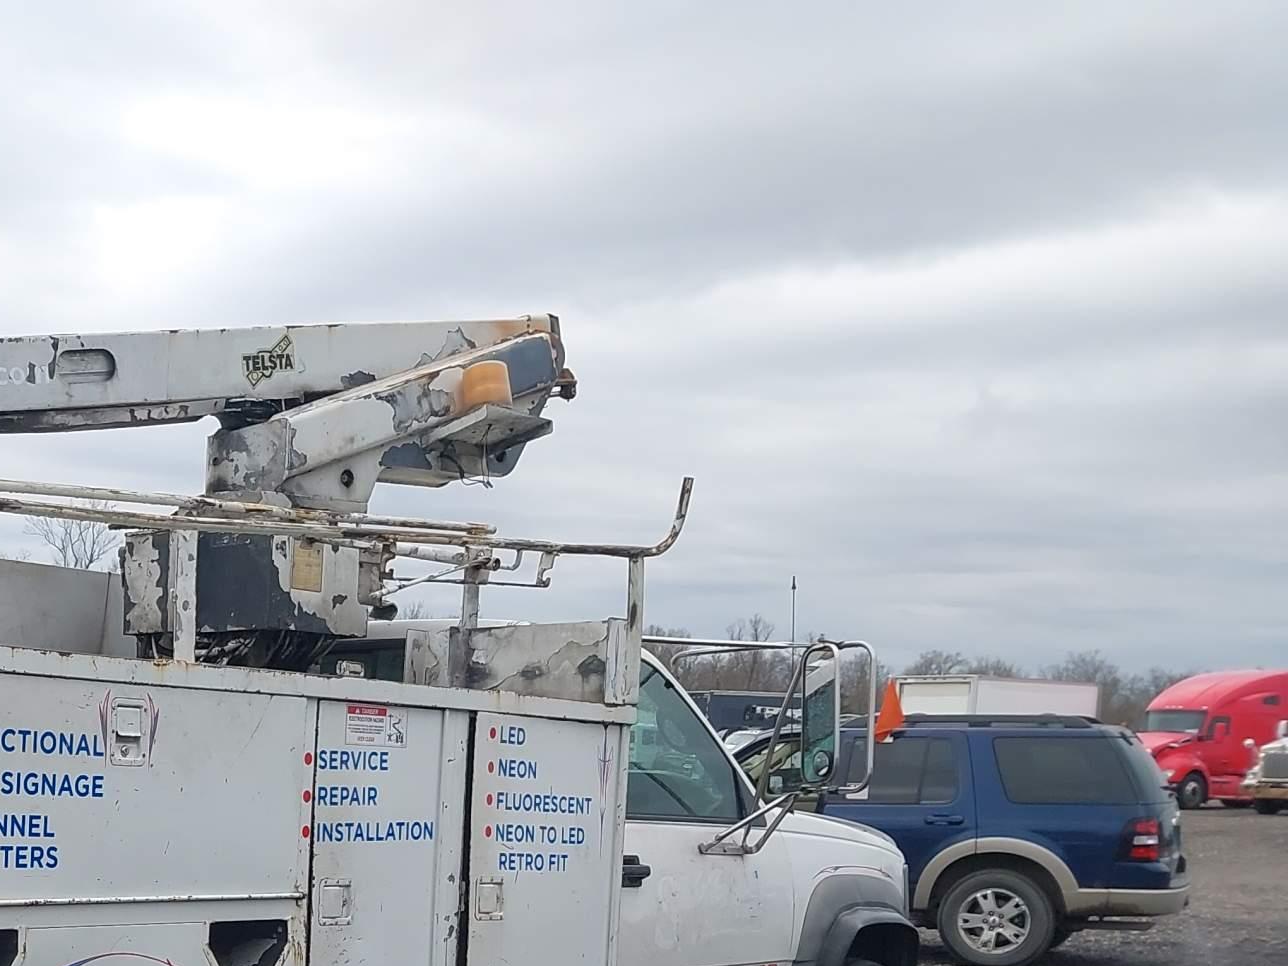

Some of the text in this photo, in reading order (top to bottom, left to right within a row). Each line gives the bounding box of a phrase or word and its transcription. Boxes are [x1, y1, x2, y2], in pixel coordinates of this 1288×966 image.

[242, 353, 294, 372] TELSTA
[499, 725, 526, 745] LED
[318, 750, 389, 771] SERVICE
[497, 758, 537, 779] NEON
[0, 771, 104, 798] SIGNAGE
[317, 786, 378, 807] REPAIR
[496, 792, 593, 815] FLUORESCENT
[316, 821, 434, 843] INSTALLATION
[495, 824, 585, 845] NEON TO LED
[498, 853, 568, 872] RETRO FIT
